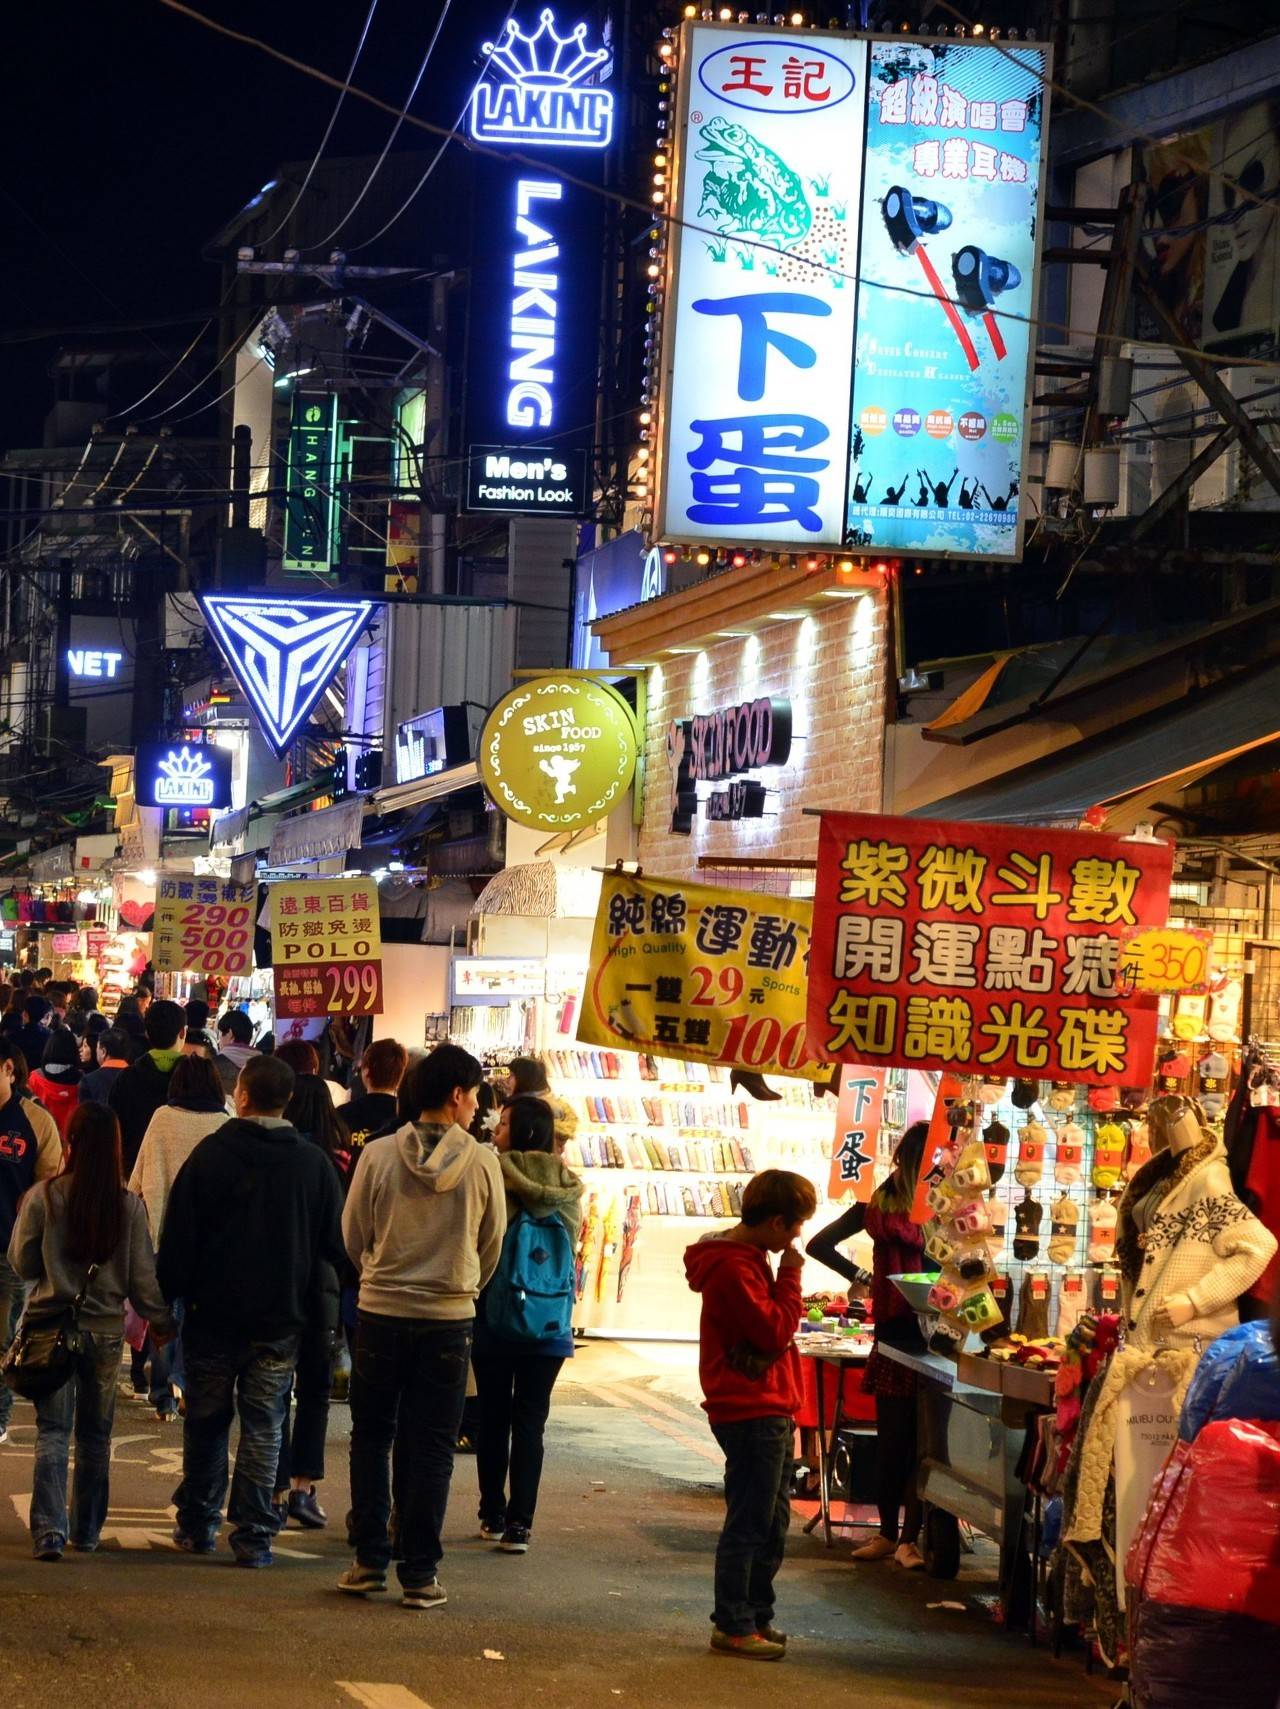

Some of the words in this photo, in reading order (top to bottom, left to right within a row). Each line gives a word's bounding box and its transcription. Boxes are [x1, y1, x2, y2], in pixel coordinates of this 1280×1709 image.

[721, 54, 832, 102] 王記
[880, 73, 1029, 132] 超級演唱會
[913, 137, 1028, 182] 專業耳機
[506, 178, 563, 429] LAKING
[685, 292, 833, 533] 下蛋
[303, 435, 318, 498] HANG
[485, 455, 568, 482] Men's
[478, 485, 535, 501] Fashion
[537, 486, 574, 503] Look
[522, 707, 576, 736] SKIN
[560, 726, 602, 739] FOOD
[840, 840, 1141, 926] 紫微斗數
[180, 904, 250, 928] 290
[279, 893, 369, 915] 遠東百貨
[180, 926, 249, 950] 500
[283, 940, 370, 959] POLO
[608, 944, 637, 957] High
[642, 943, 687, 956] Quality
[834, 914, 1122, 999] 開運點痣
[181, 948, 247, 973] 700
[1149, 943, 1204, 984] 350
[326, 964, 378, 1012] 299
[625, 976, 683, 1004] 一雙
[689, 966, 744, 1007] 29
[749, 988, 766, 1004] 元
[762, 977, 801, 996] Sports
[652, 1015, 711, 1046] 五雙
[710, 1013, 810, 1071] 100
[827, 989, 1128, 1075] 知識光碟
[835, 1078, 878, 1182] 下蛋
